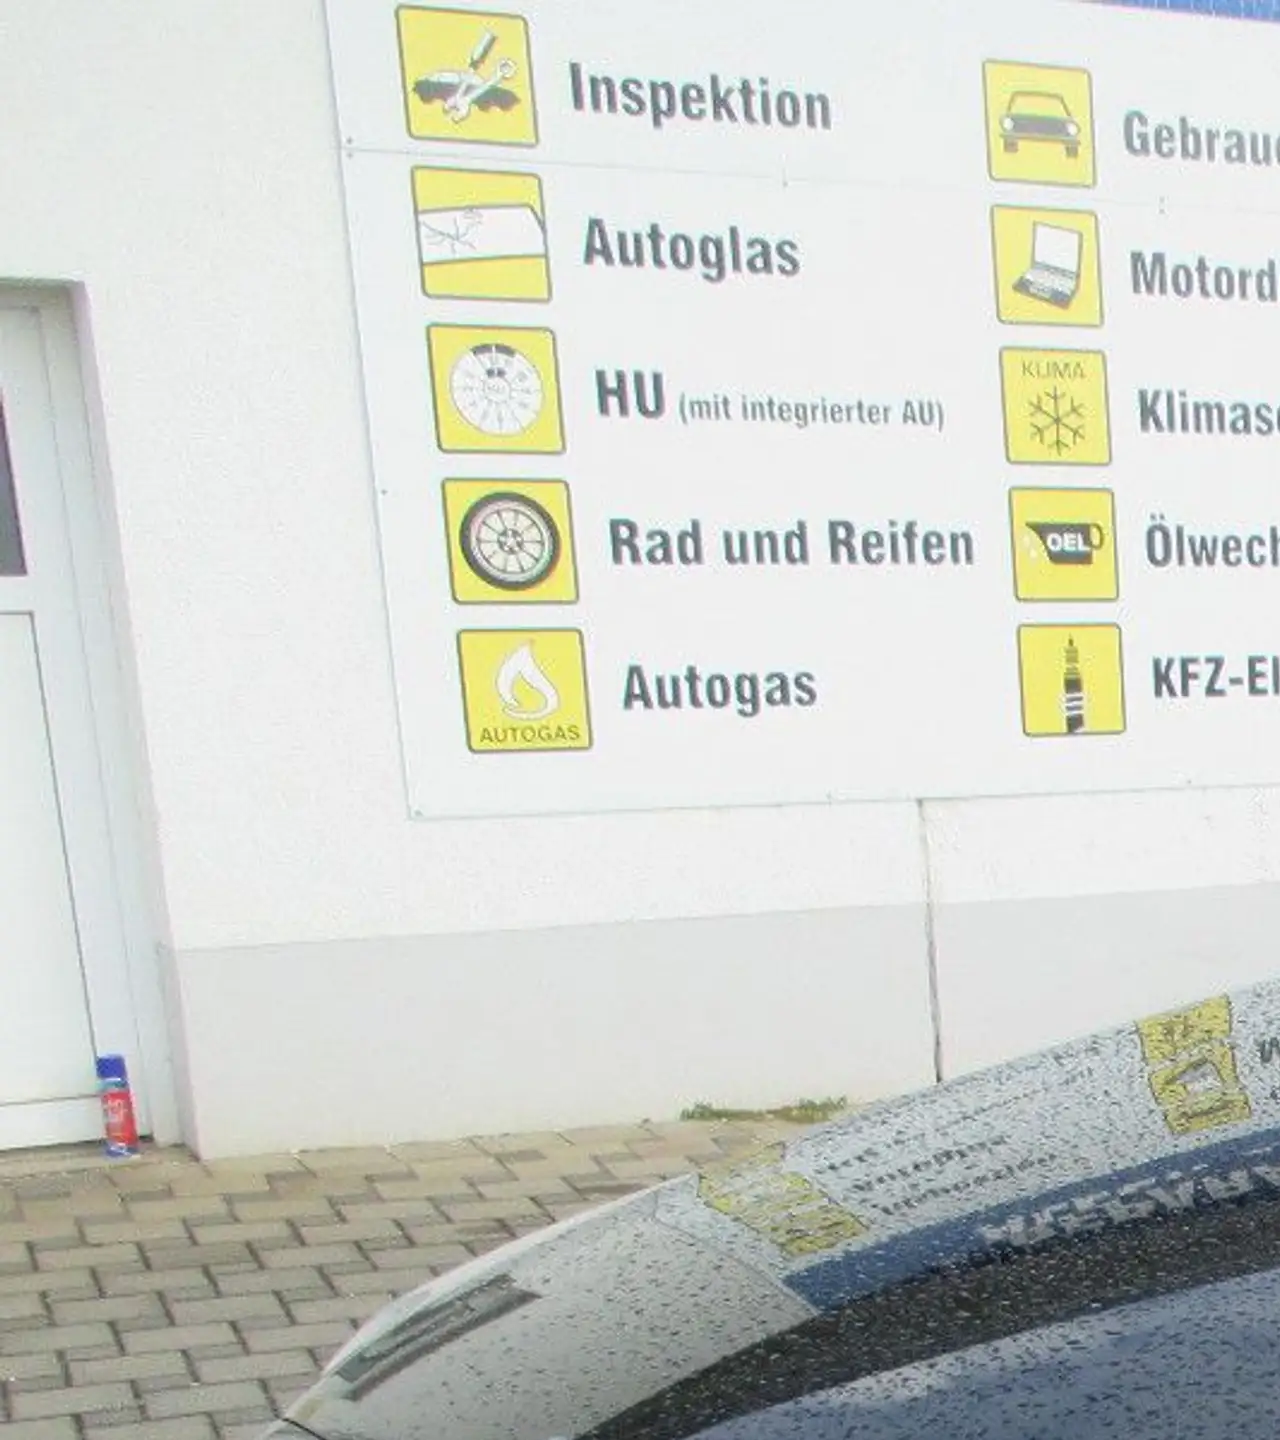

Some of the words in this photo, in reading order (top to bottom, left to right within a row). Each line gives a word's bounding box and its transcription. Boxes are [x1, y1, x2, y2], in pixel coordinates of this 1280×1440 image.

[569, 61, 832, 130] Inspektion
[584, 218, 801, 283] Autoglas
[1021, 360, 1086, 380] KLIMA
[595, 369, 666, 419] HU
[678, 391, 733, 424] (mit
[740, 395, 893, 428] integrierter
[902, 401, 945, 433] AU)
[609, 518, 703, 566] Rad
[723, 520, 810, 567] und
[828, 520, 975, 566] Reifen
[1046, 532, 1090, 553] OEL
[623, 664, 818, 717] Autogas
[479, 723, 581, 745] AUTOGAS
